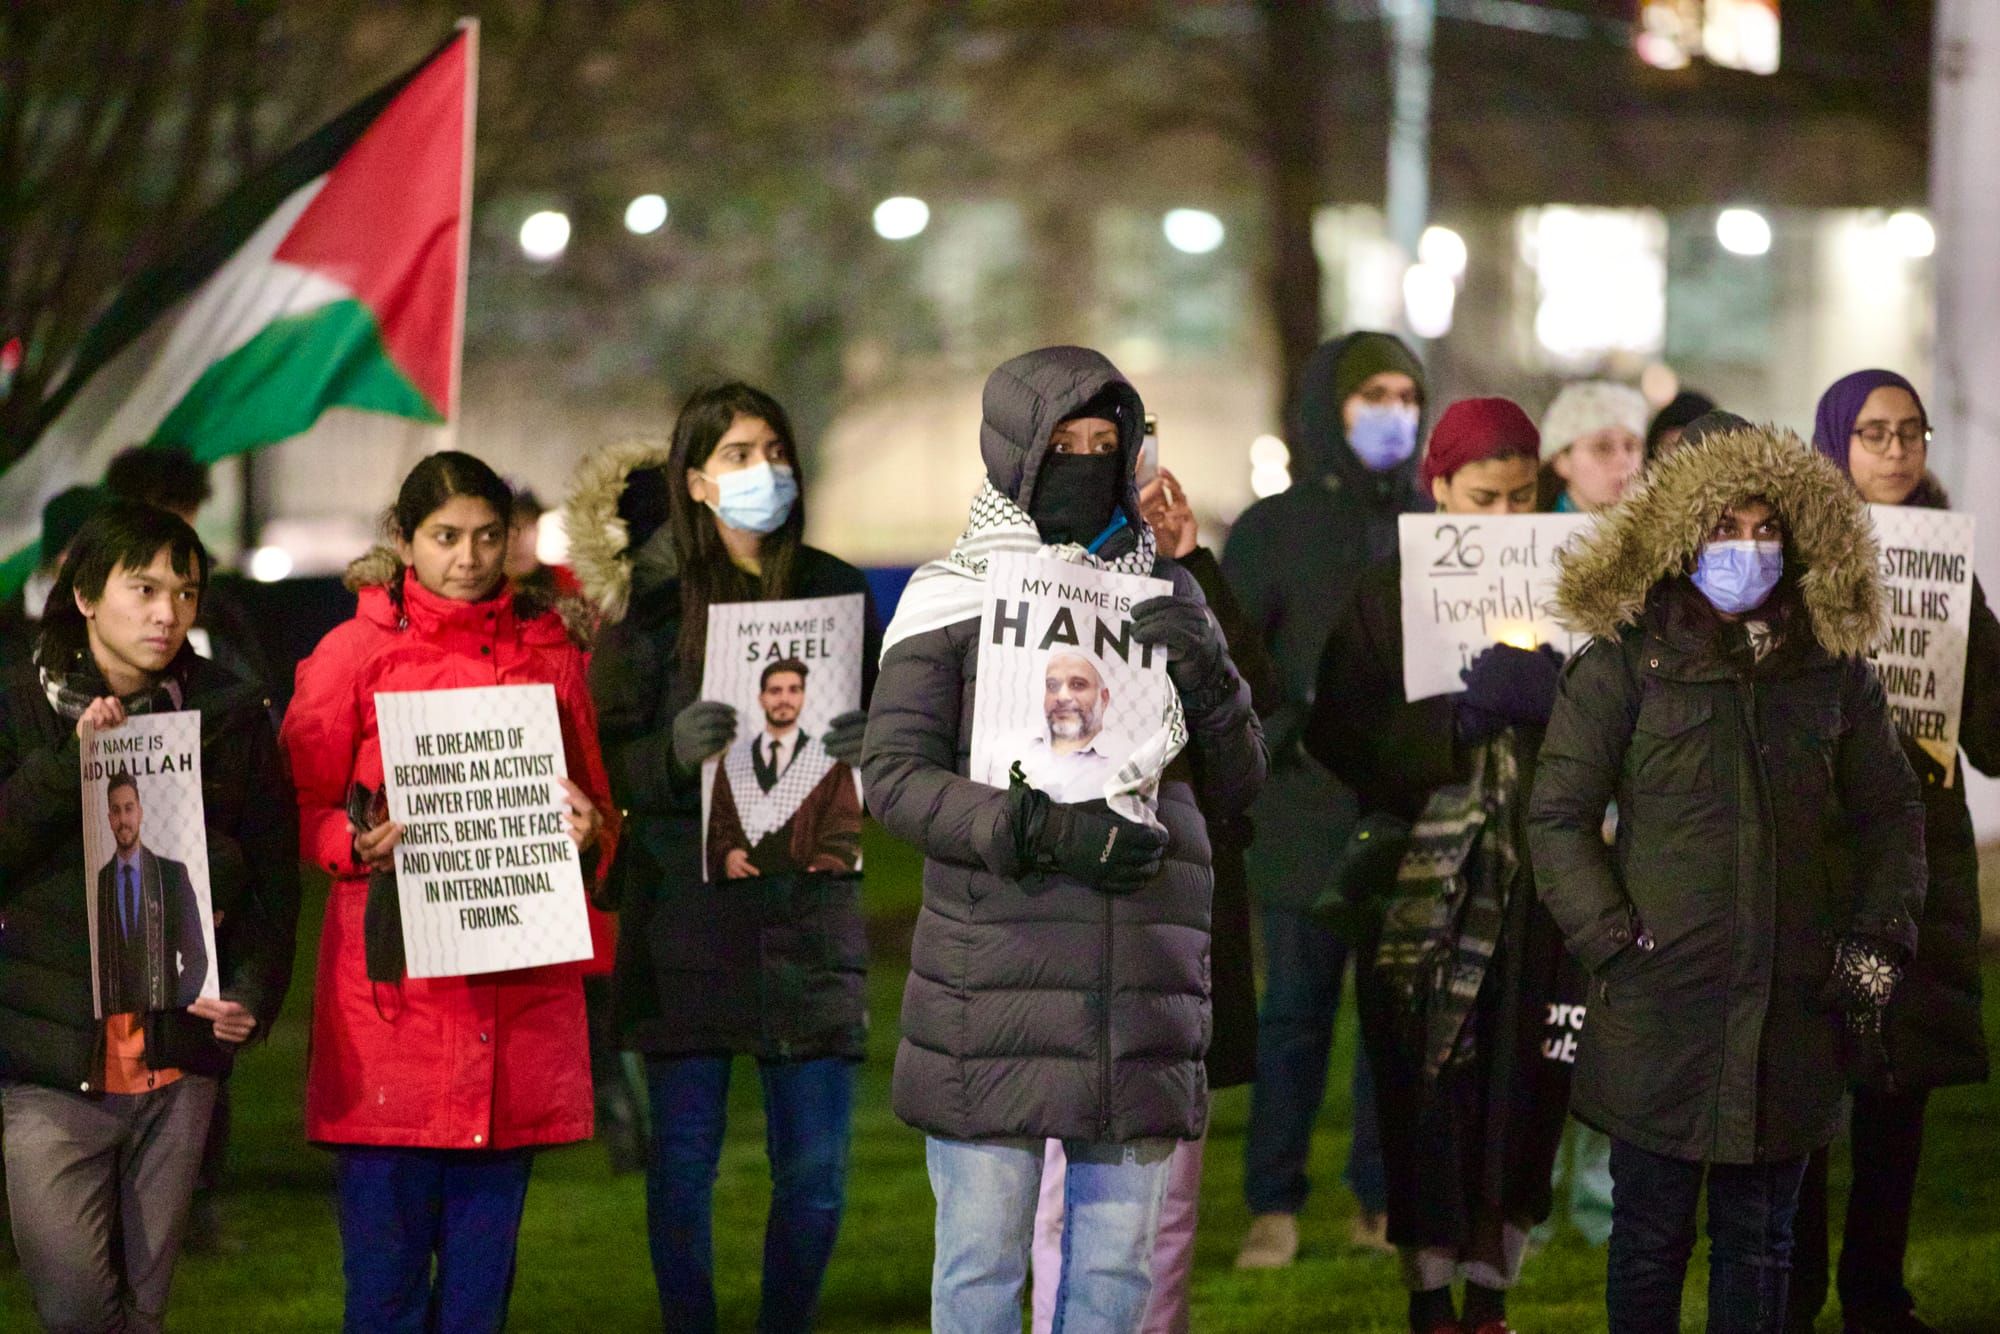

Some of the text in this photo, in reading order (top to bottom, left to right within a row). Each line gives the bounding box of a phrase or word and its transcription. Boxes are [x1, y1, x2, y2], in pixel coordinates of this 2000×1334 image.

[1432, 523, 1485, 569] 26
[1500, 527, 1537, 568] out
[1885, 547, 1966, 583] STRIVING
[1021, 578, 1132, 613] MY NAME IS
[1921, 589, 1949, 622] HIS
[738, 617, 836, 638] MY NAME IS
[1910, 628, 1931, 659] OF
[1923, 669, 1936, 700] A
[103, 736, 144, 755] NAME
[148, 735, 164, 751] IS
[415, 727, 525, 757] HE DREAMED OF
[394, 754, 555, 787] BECOMING AN ACTIVIST
[406, 783, 551, 816] LAWYER FOR HUMAN
[401, 811, 565, 846] RIGHTS, BEING THE FACE
[402, 840, 572, 875] AND VOICE OF PALESTINE
[424, 871, 555, 903] IN INTERNATIONAL
[459, 905, 523, 931] FORUMS.
